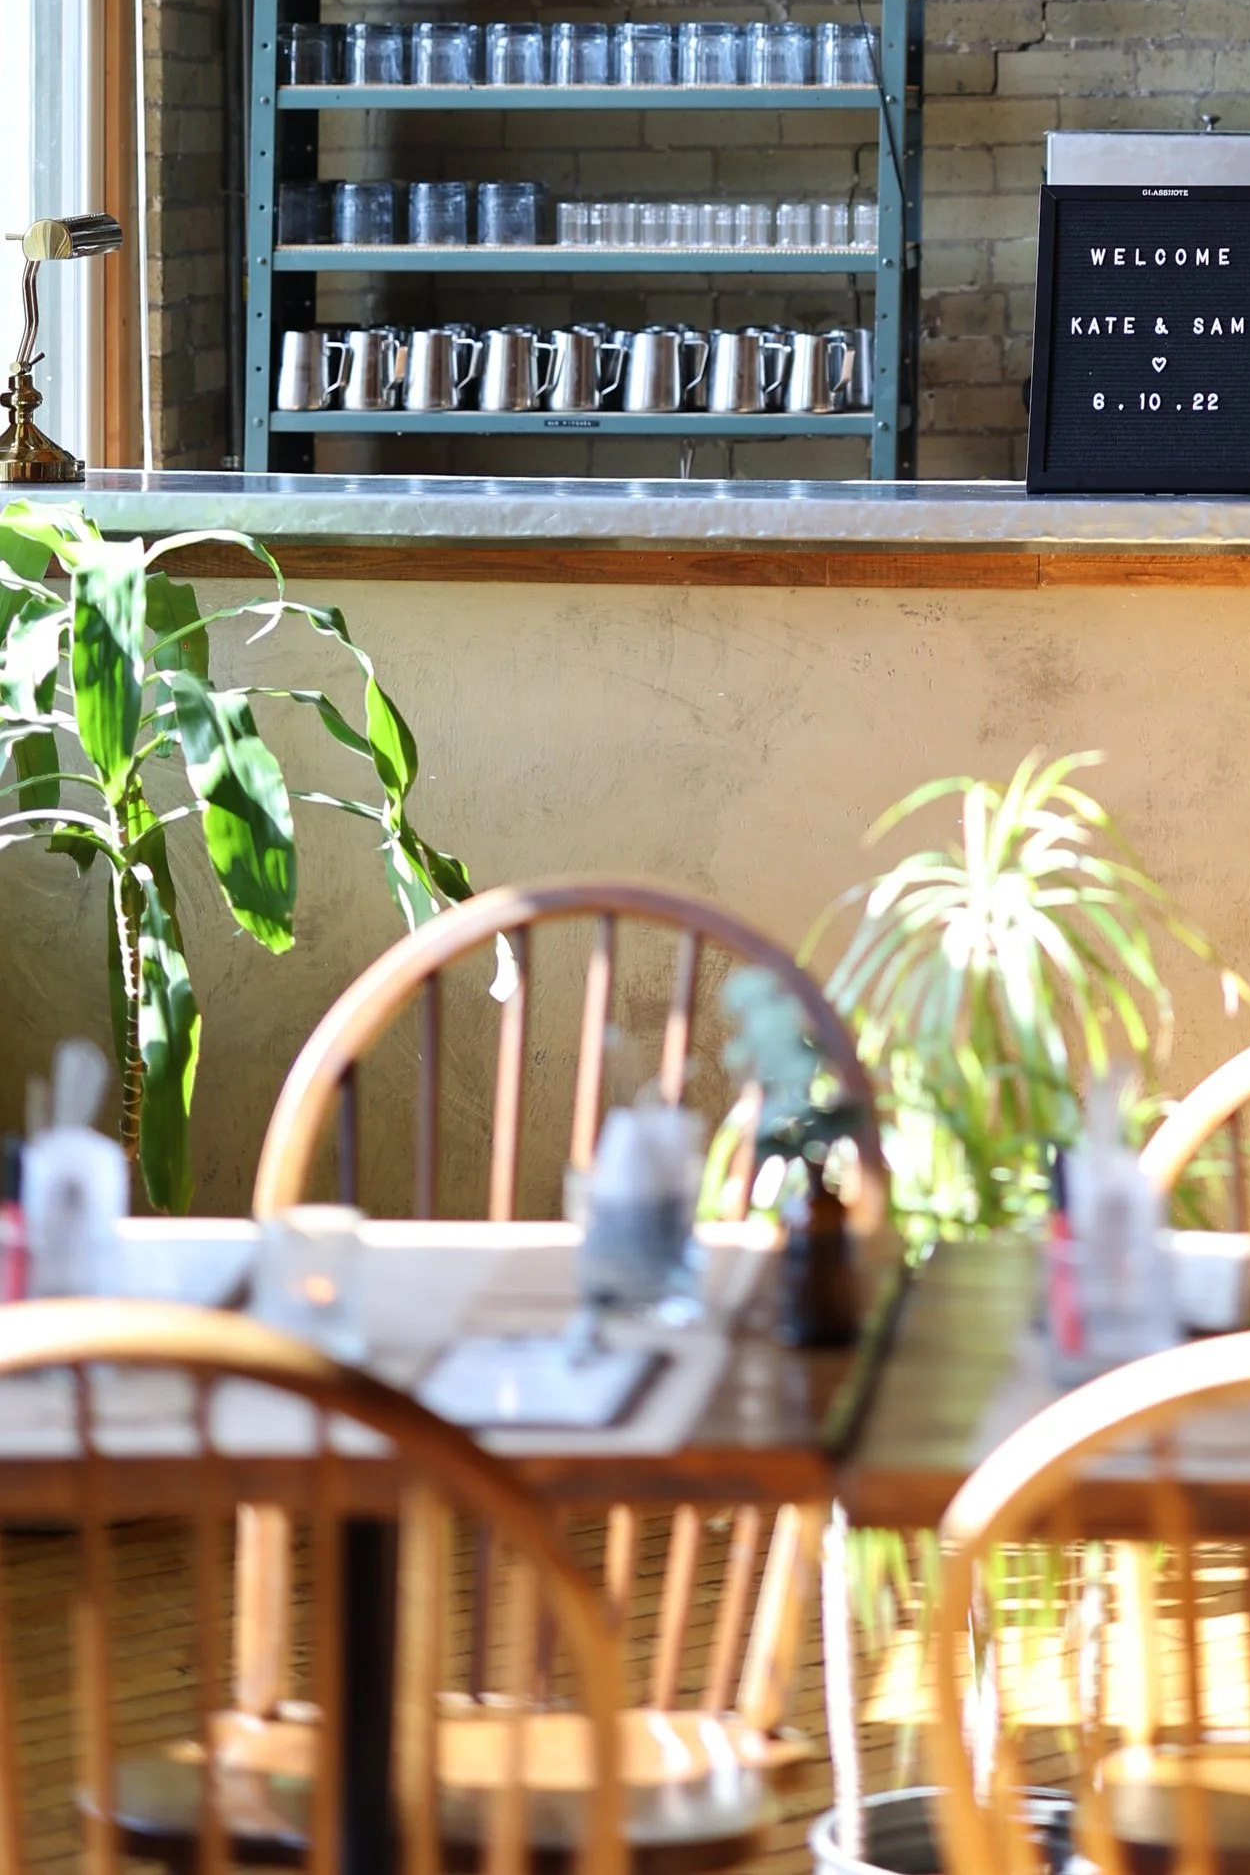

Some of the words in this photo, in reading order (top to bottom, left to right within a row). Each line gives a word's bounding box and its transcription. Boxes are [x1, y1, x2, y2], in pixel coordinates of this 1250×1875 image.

[1090, 248, 1230, 266] WELCOME
[1072, 317, 1135, 334] KATE
[1155, 317, 1168, 334] &
[1193, 317, 1244, 335] SAM
